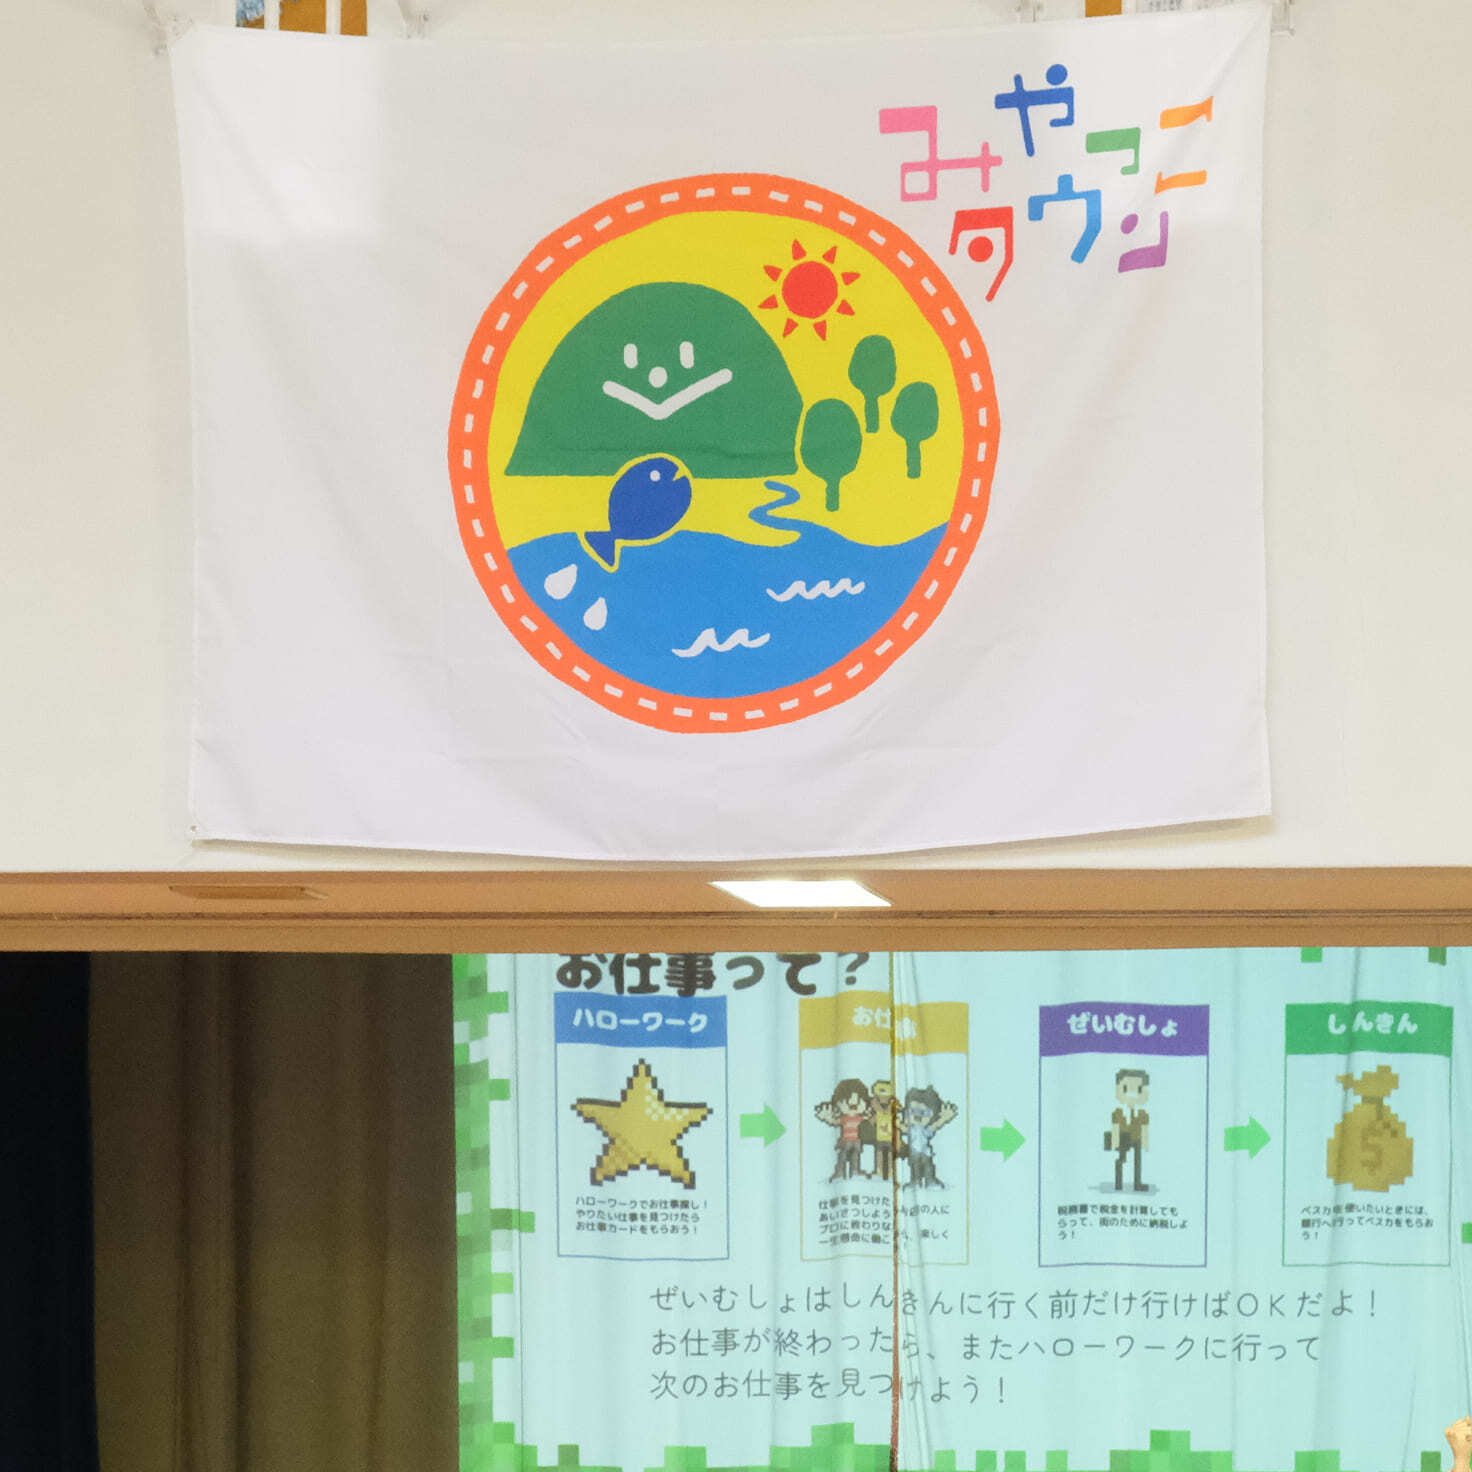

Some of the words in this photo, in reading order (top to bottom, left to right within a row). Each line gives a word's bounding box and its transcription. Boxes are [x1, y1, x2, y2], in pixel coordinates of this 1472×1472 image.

[879, 63, 1214, 201] みやっこ
[949, 174, 1169, 302] タウン
[556, 953, 870, 997] お仕事って？
[572, 1007, 709, 1033] ハローワーク
[1067, 1011, 1179, 1038] ぜいむしょ
[1327, 1011, 1418, 1036] しんきん
[650, 1326, 1321, 1363] お仕事が終わったら、またハローワークに行って
[650, 1367, 1005, 1404] 次のお仕事を見つけよう！
